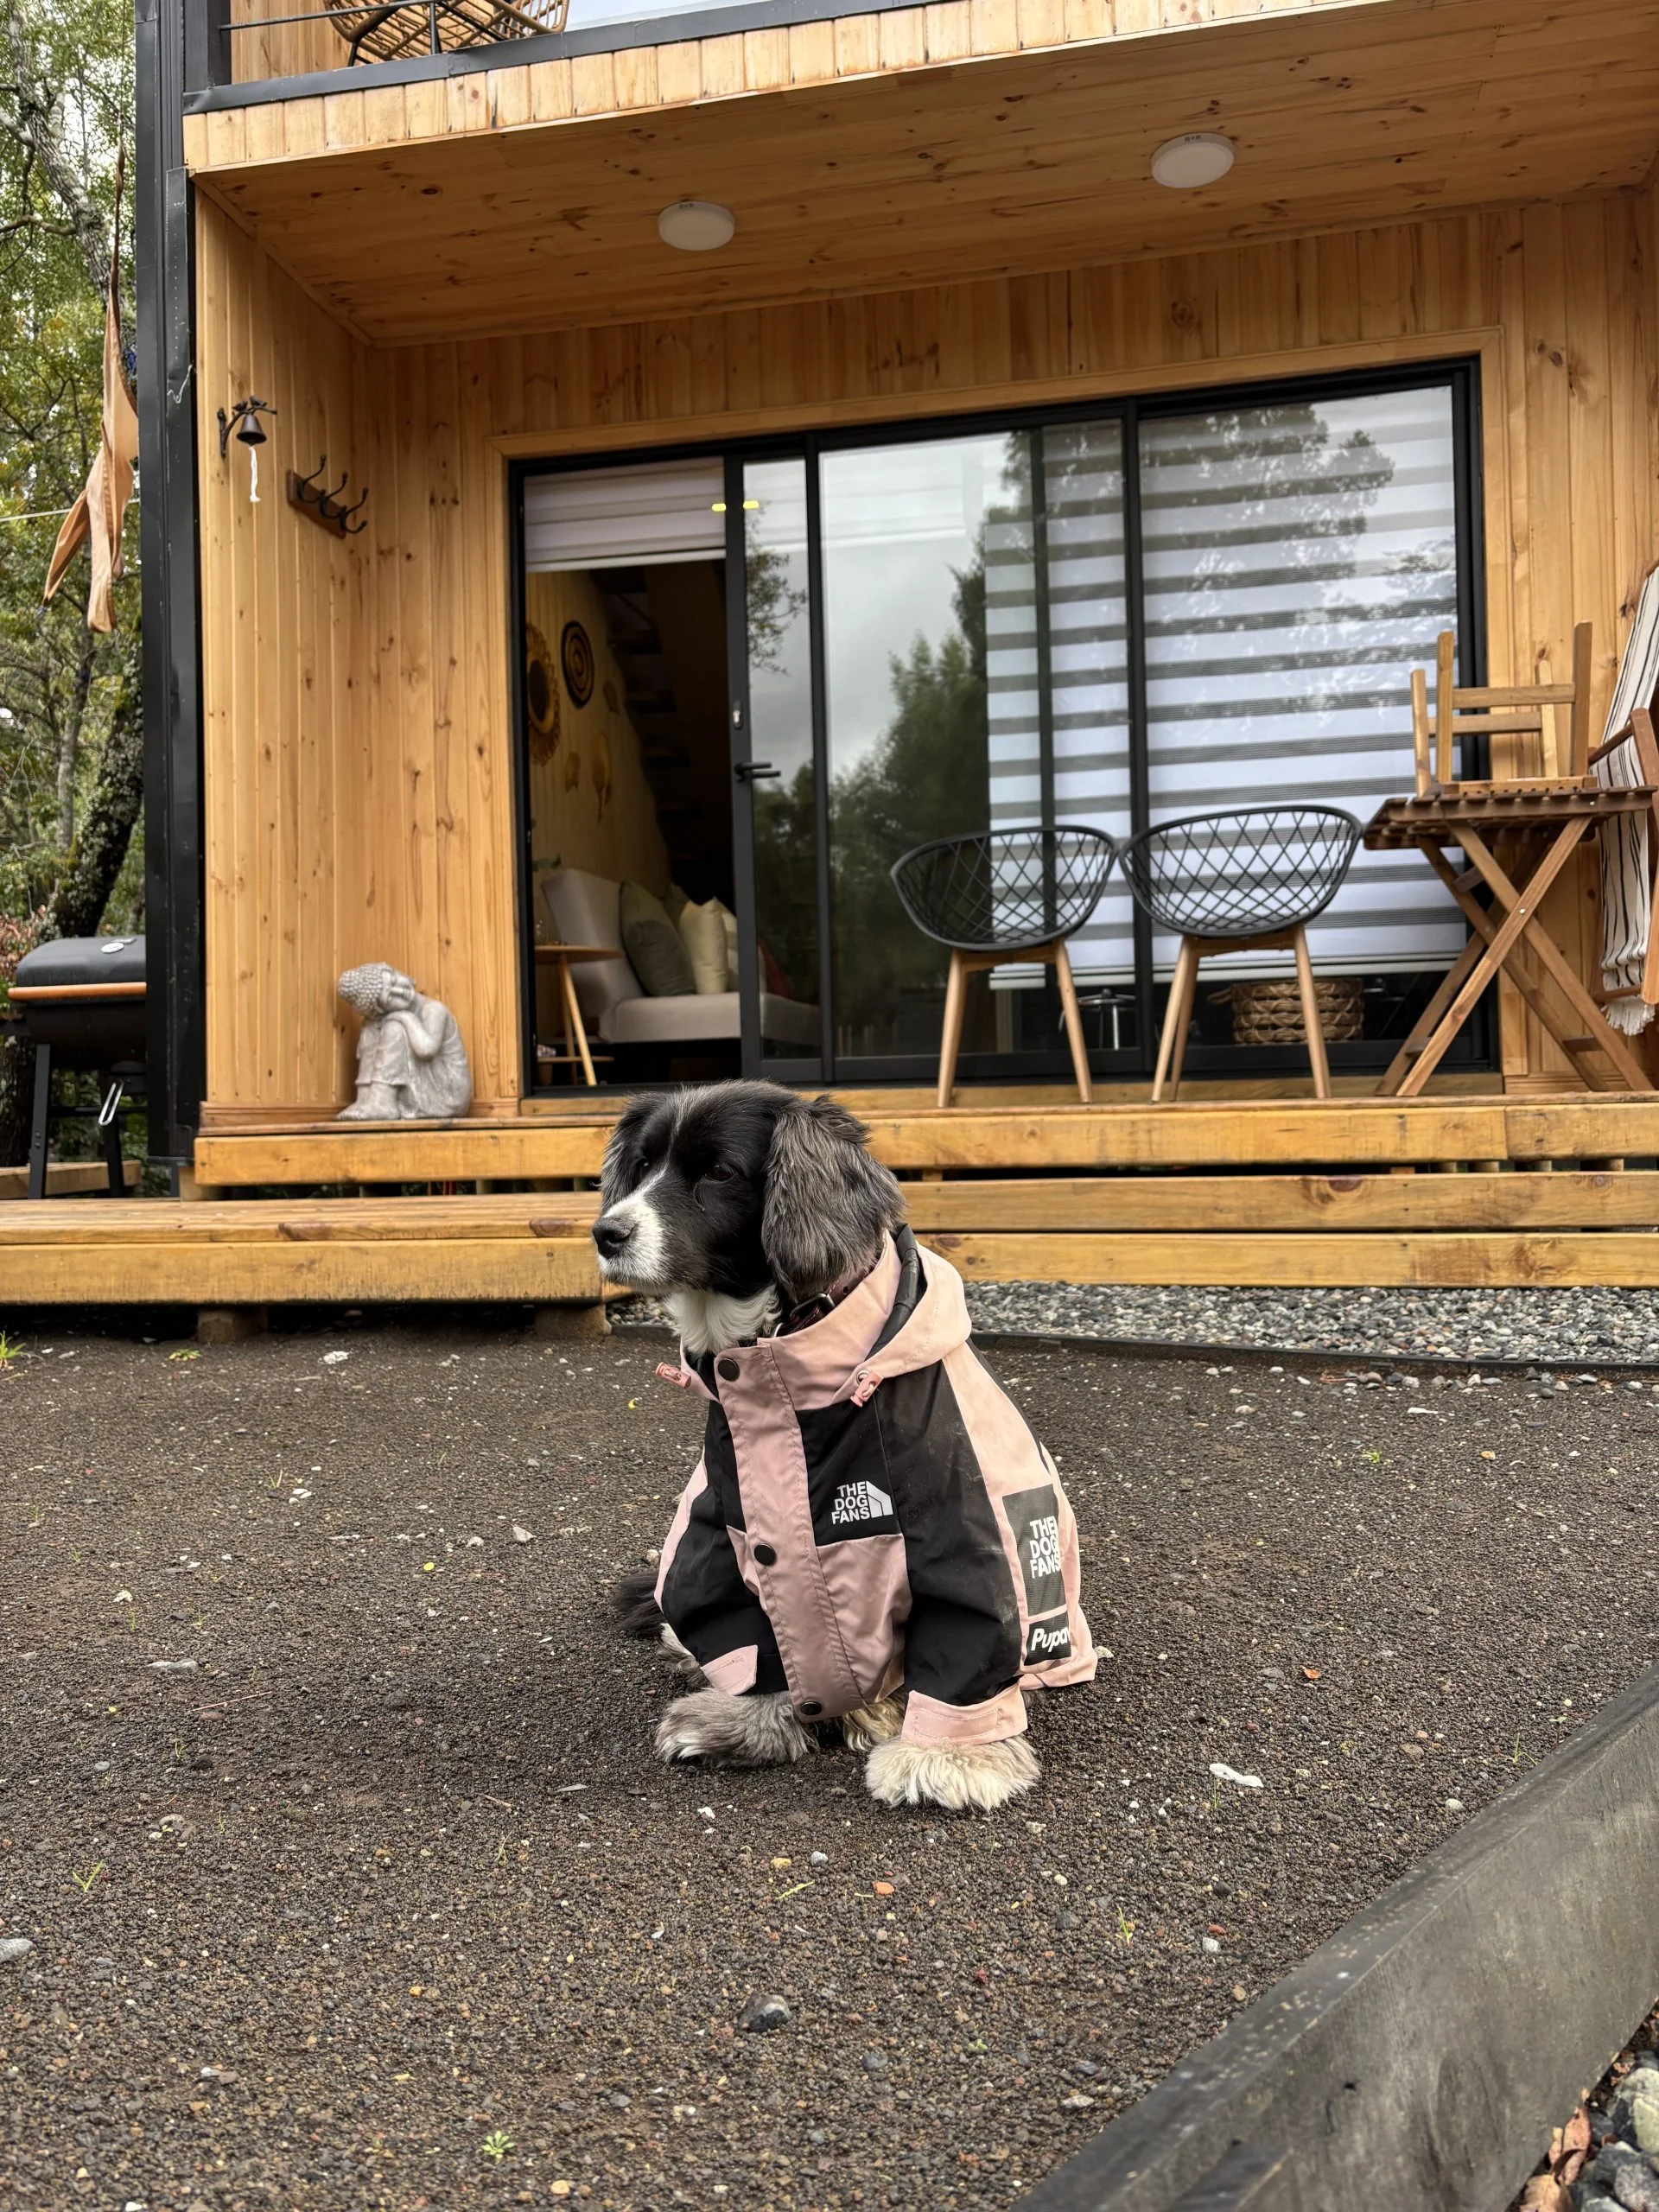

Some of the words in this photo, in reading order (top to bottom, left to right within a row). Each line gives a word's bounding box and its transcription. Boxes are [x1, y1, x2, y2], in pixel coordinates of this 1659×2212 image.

[836, 1481, 867, 1497] THE
[834, 1495, 868, 1510] DOG
[831, 1507, 870, 1524] FANS
[1029, 1516, 1057, 1539] THE
[1029, 1535, 1059, 1559] DOG
[1029, 1554, 1061, 1579] FANS
